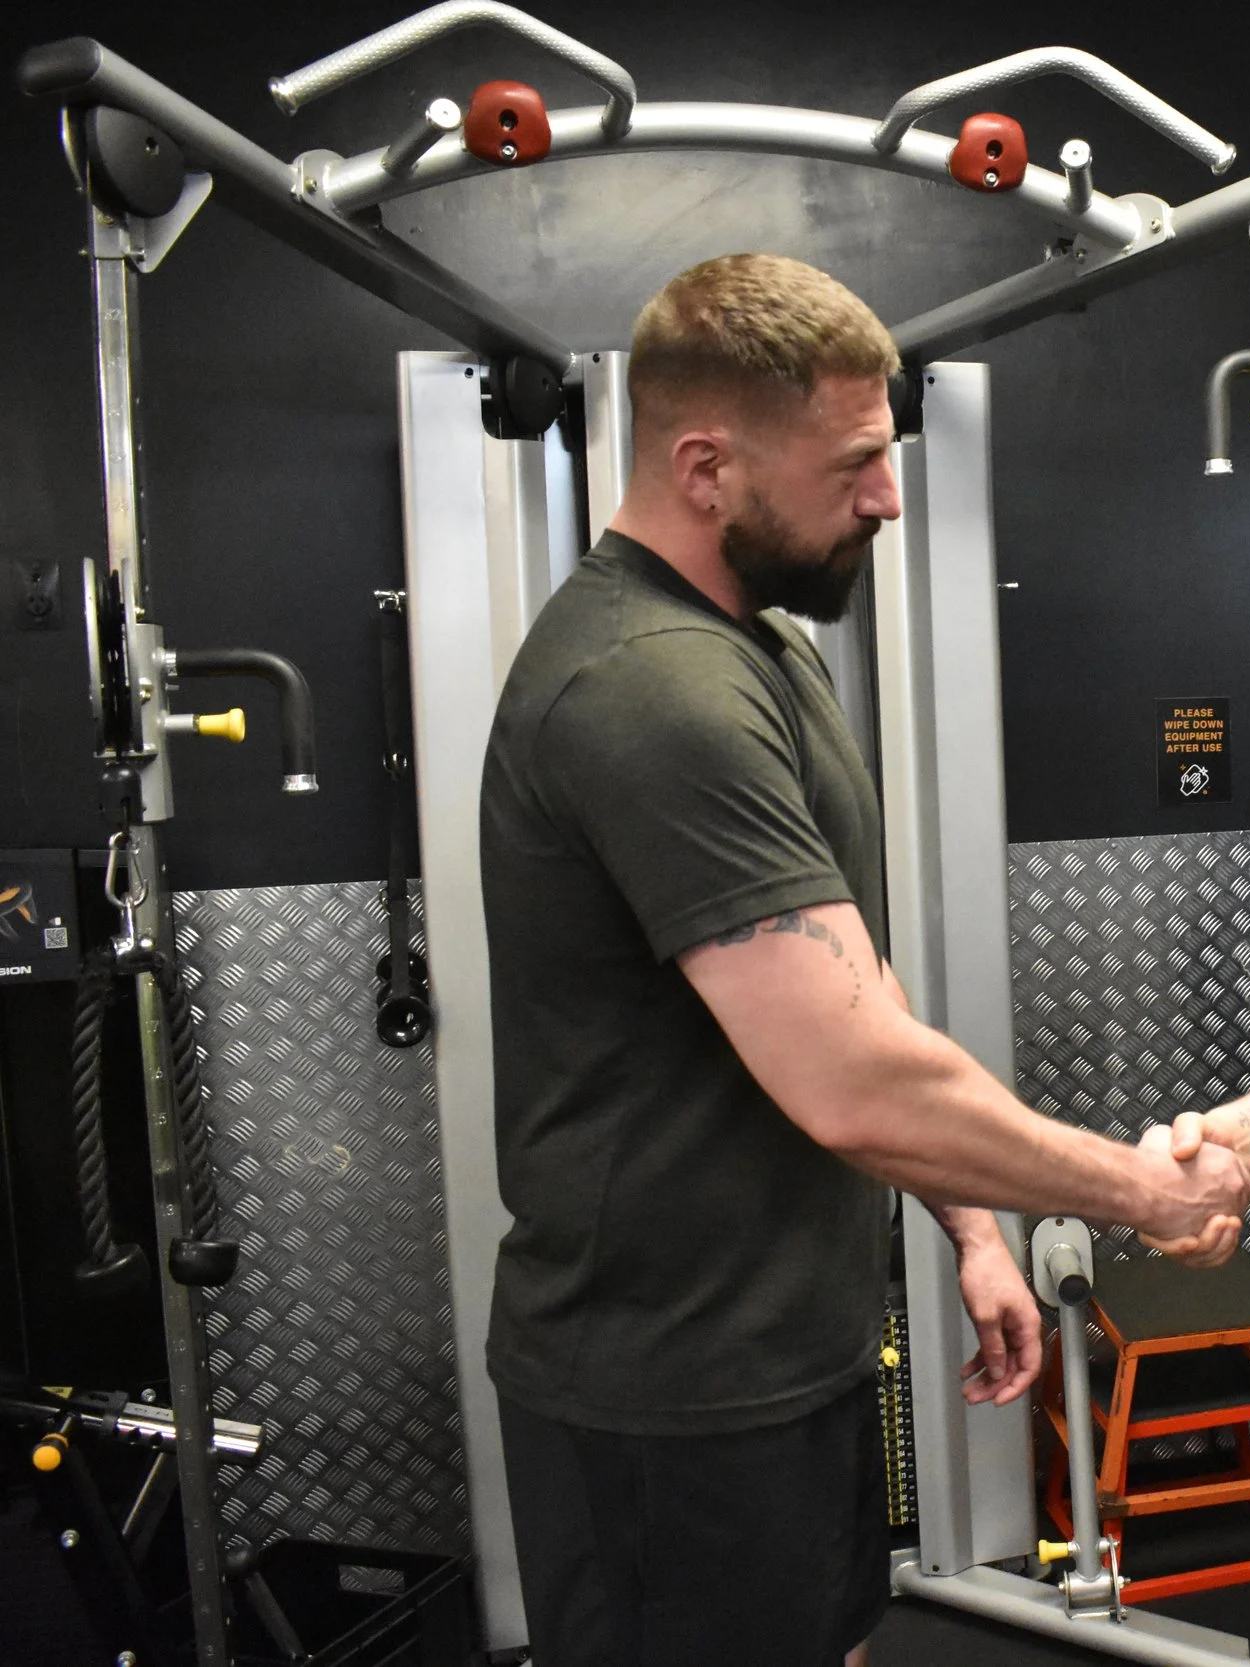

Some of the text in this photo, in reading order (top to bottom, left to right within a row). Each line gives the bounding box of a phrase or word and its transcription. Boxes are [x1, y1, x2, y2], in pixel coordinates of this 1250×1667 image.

[1174, 708, 1214, 717] PLEASE
[1164, 720, 1224, 729] WIPE DOWN
[1165, 732, 1223, 741] EQUIPMENT
[1166, 743, 1222, 753] AFTER USE
